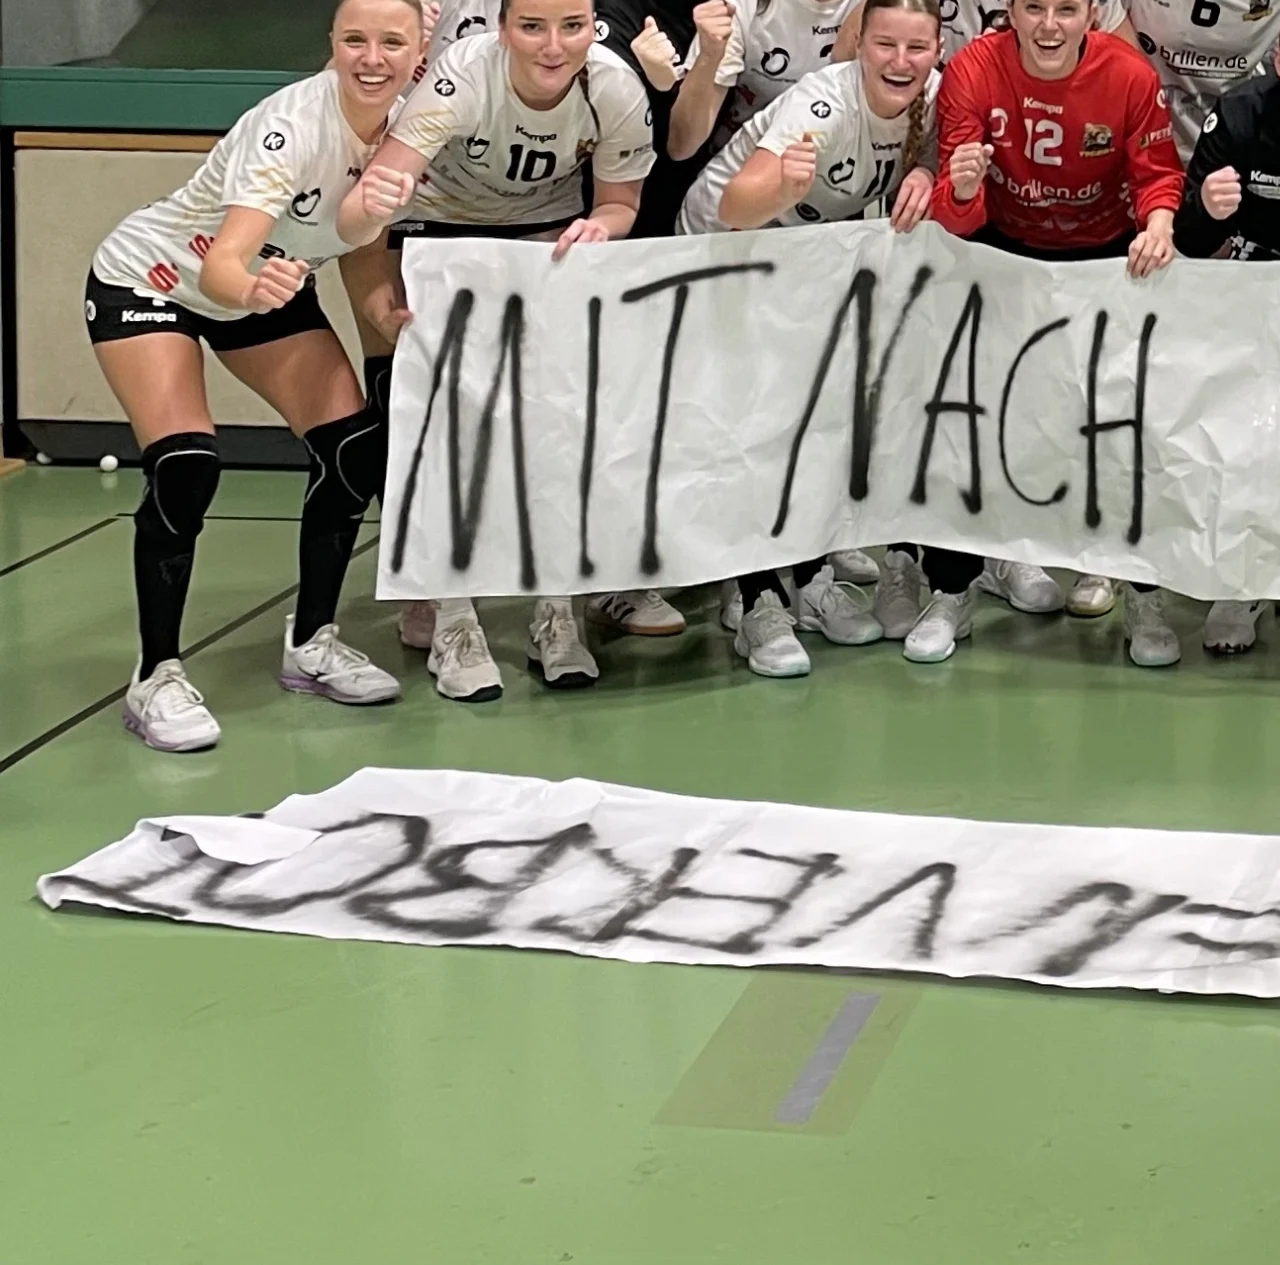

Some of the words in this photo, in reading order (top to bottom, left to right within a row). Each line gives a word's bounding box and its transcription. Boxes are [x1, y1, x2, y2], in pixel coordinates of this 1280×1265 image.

[1160, 45, 1248, 70] brillen.de
[1023, 96, 1064, 115] Kempa
[1023, 118, 1064, 166] 12
[505, 143, 557, 183] 10
[862, 159, 896, 199] 11
[1007, 178, 1104, 201] brillen.de
[121, 309, 177, 324] Kempa
[390, 260, 775, 590] MIT
[770, 264, 1157, 545] NACH
